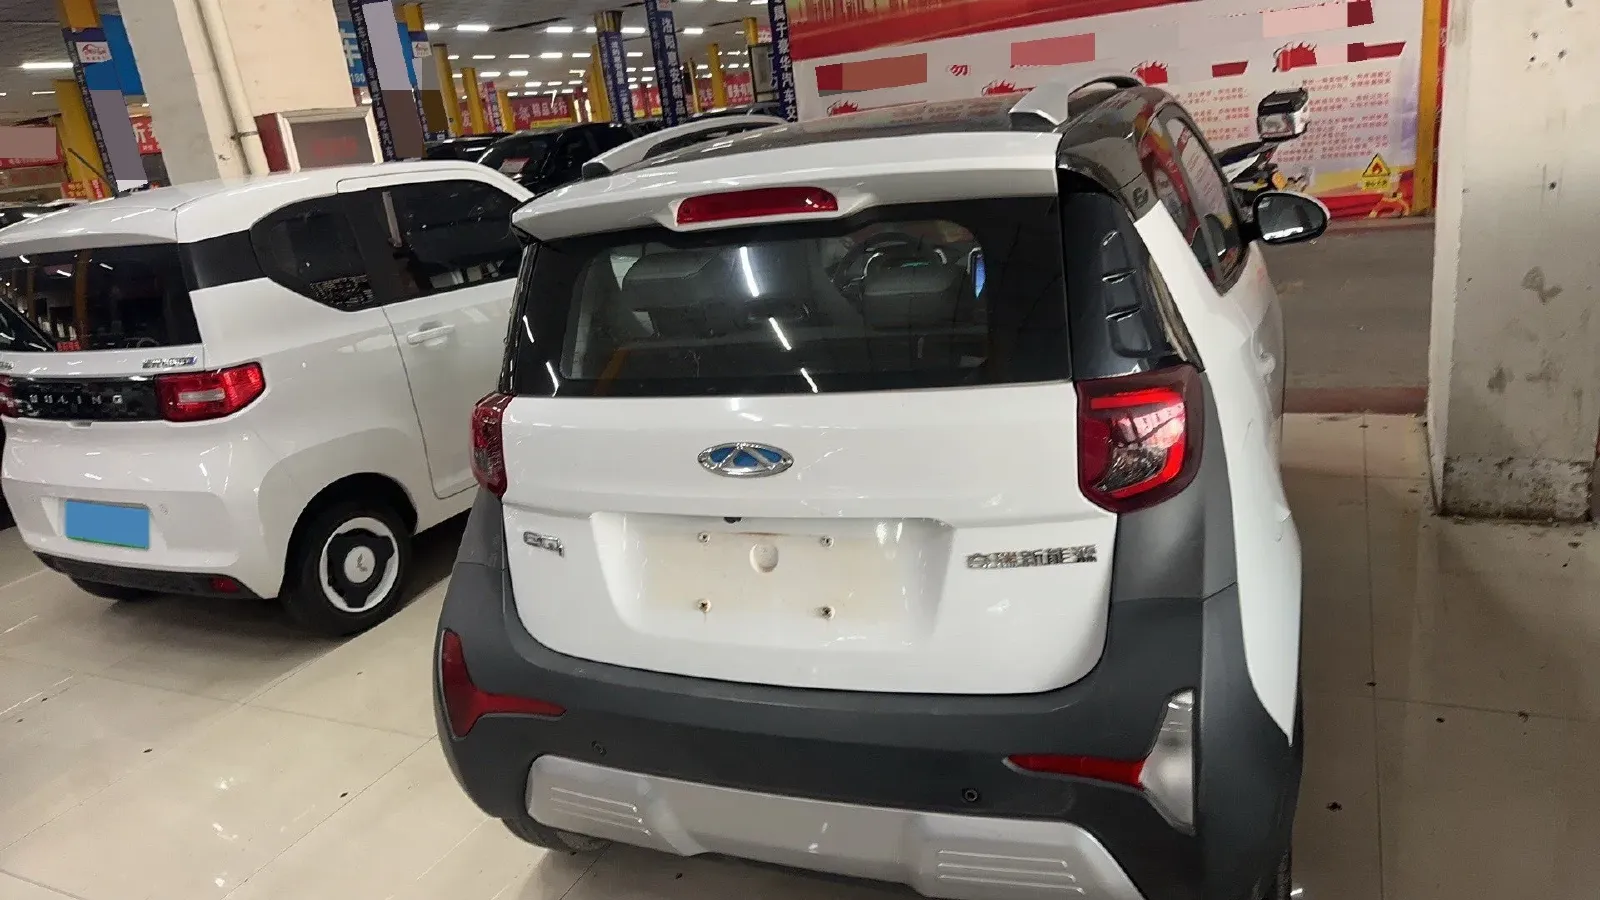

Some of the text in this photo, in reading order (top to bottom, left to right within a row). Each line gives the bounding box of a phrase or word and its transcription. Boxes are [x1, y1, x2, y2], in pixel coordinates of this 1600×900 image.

[773, 0, 798, 122] 属于豪华汽车交
